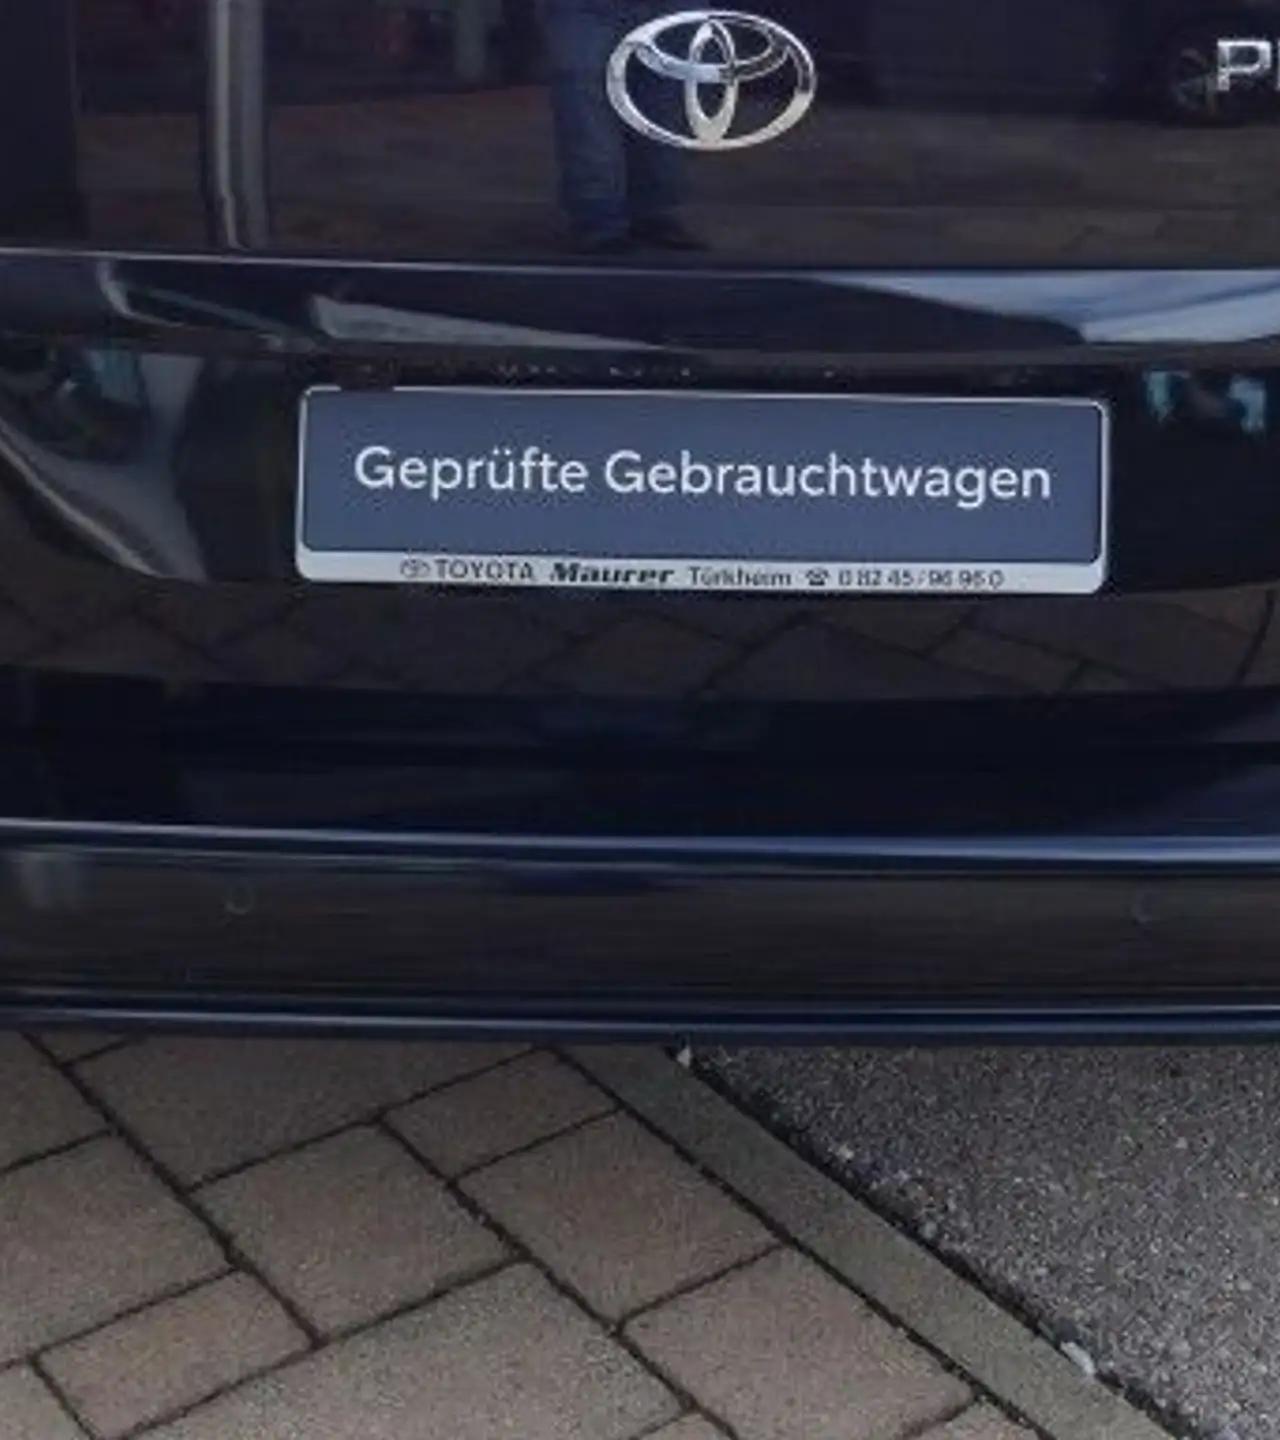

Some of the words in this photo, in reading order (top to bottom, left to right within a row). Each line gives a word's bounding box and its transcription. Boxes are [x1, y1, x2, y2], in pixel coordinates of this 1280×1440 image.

[354, 445, 588, 501] Geprüfte
[604, 448, 1051, 509] Gebrauchtwagen
[435, 559, 534, 579] TOYOTA
[549, 562, 675, 583] Maurer
[688, 566, 792, 586] Türkheim
